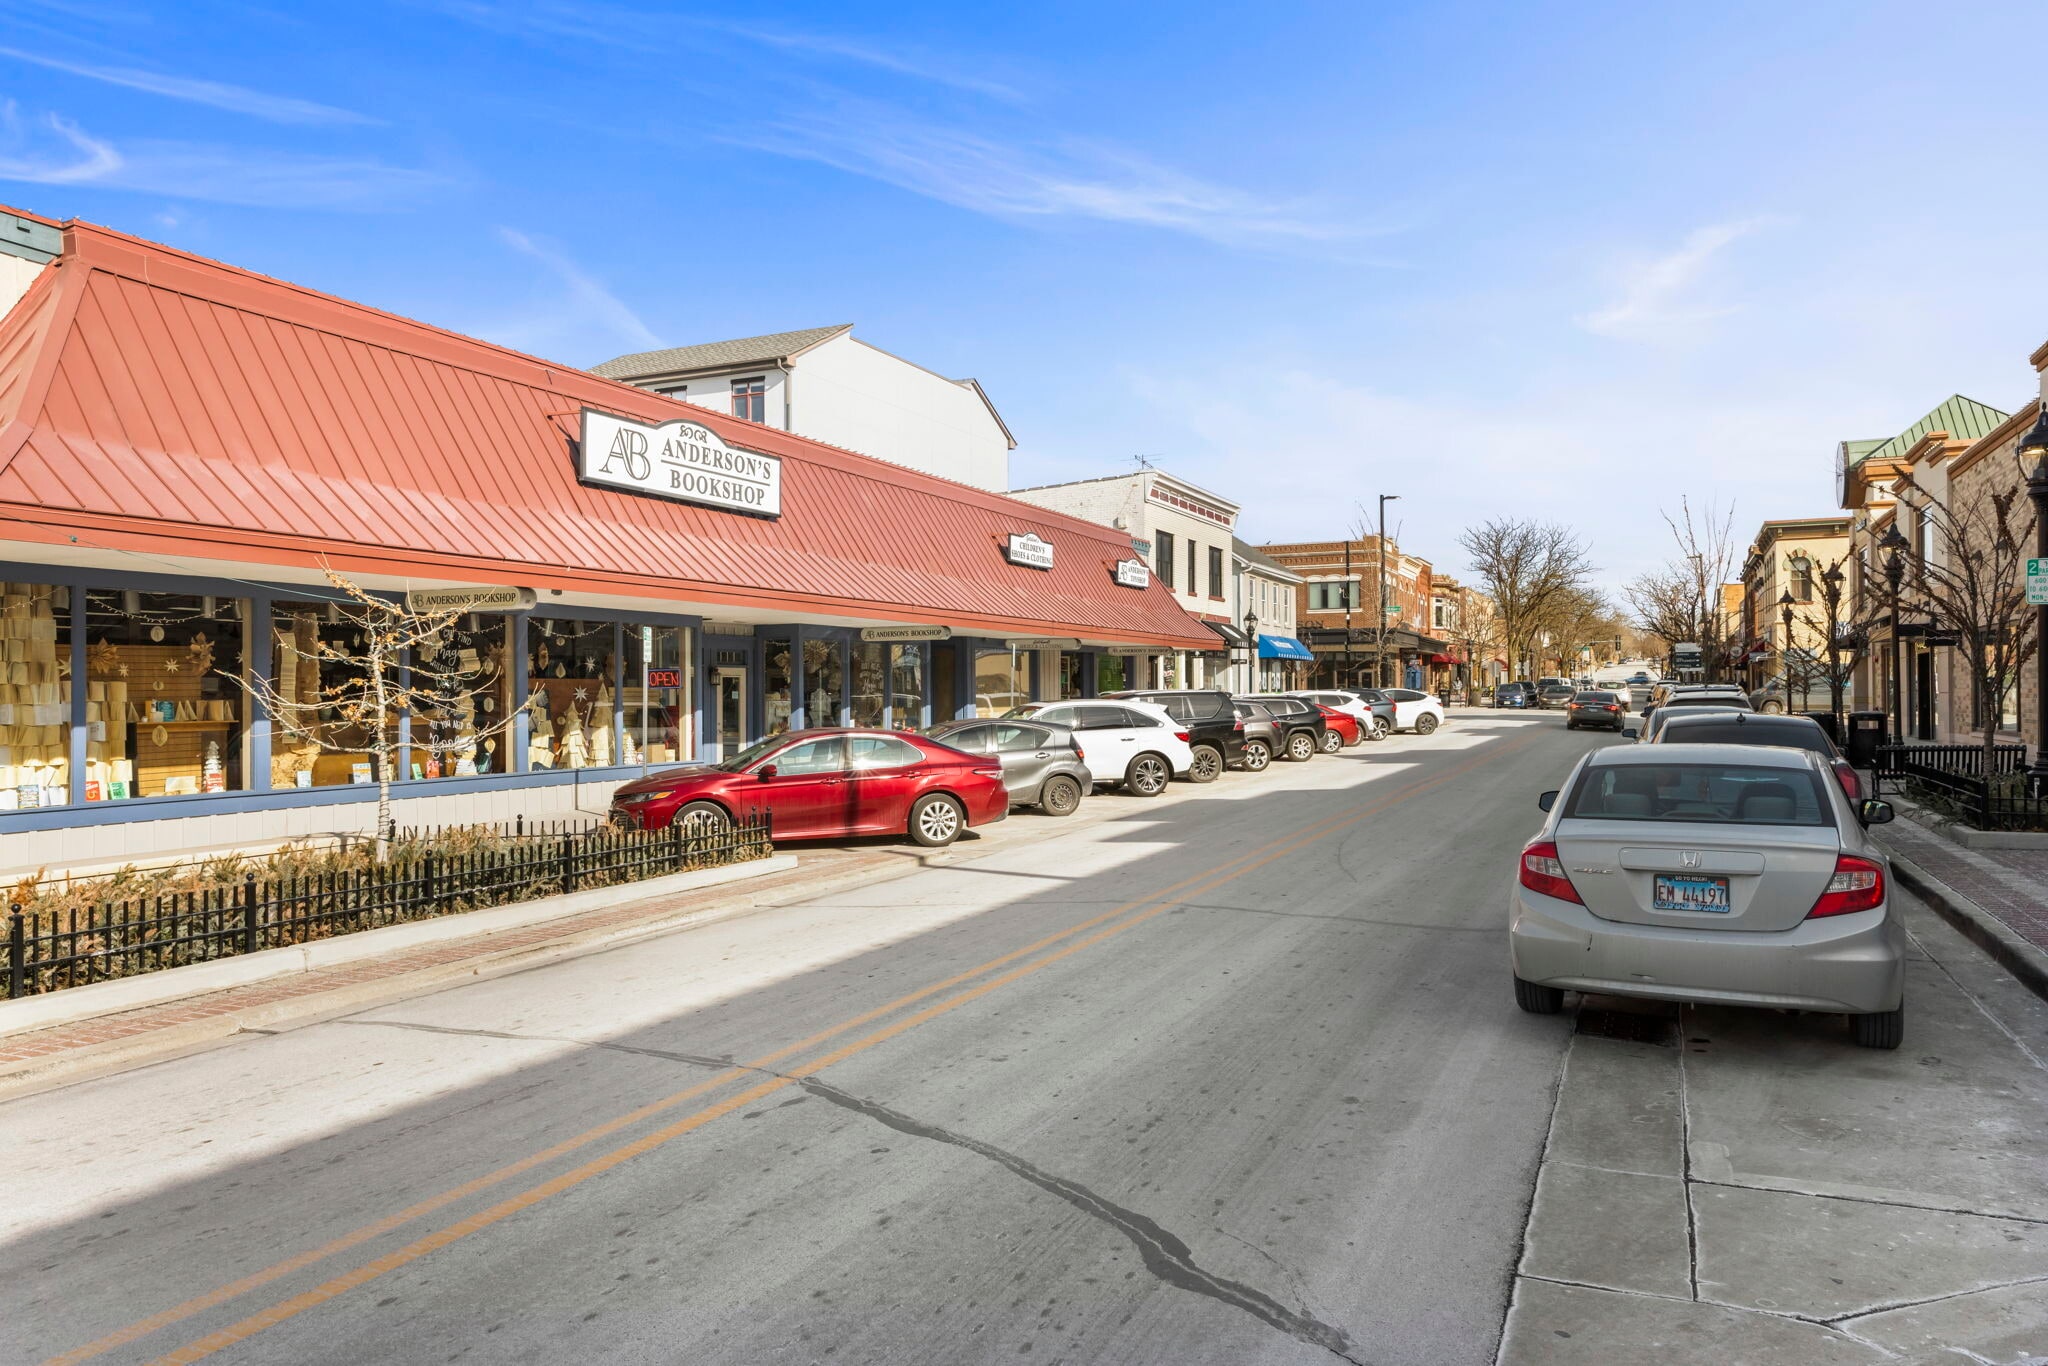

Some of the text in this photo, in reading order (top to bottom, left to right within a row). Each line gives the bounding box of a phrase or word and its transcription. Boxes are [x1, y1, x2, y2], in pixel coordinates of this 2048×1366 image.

[661, 438, 772, 480] ANDERSON'S
[669, 469, 766, 506] BOOKSHOP
[1019, 541, 1046, 554] CHILDREN'S
[2028, 562, 2037, 574] 2
[426, 594, 471, 606] ANDERSON'S
[474, 592, 516, 604] BOOKSHOP
[876, 630, 909, 638] ANDERSON'S
[911, 629, 942, 637] BOOKSHOP
[649, 671, 679, 687] OPEN
[1658, 885, 1725, 905] EM 44197
